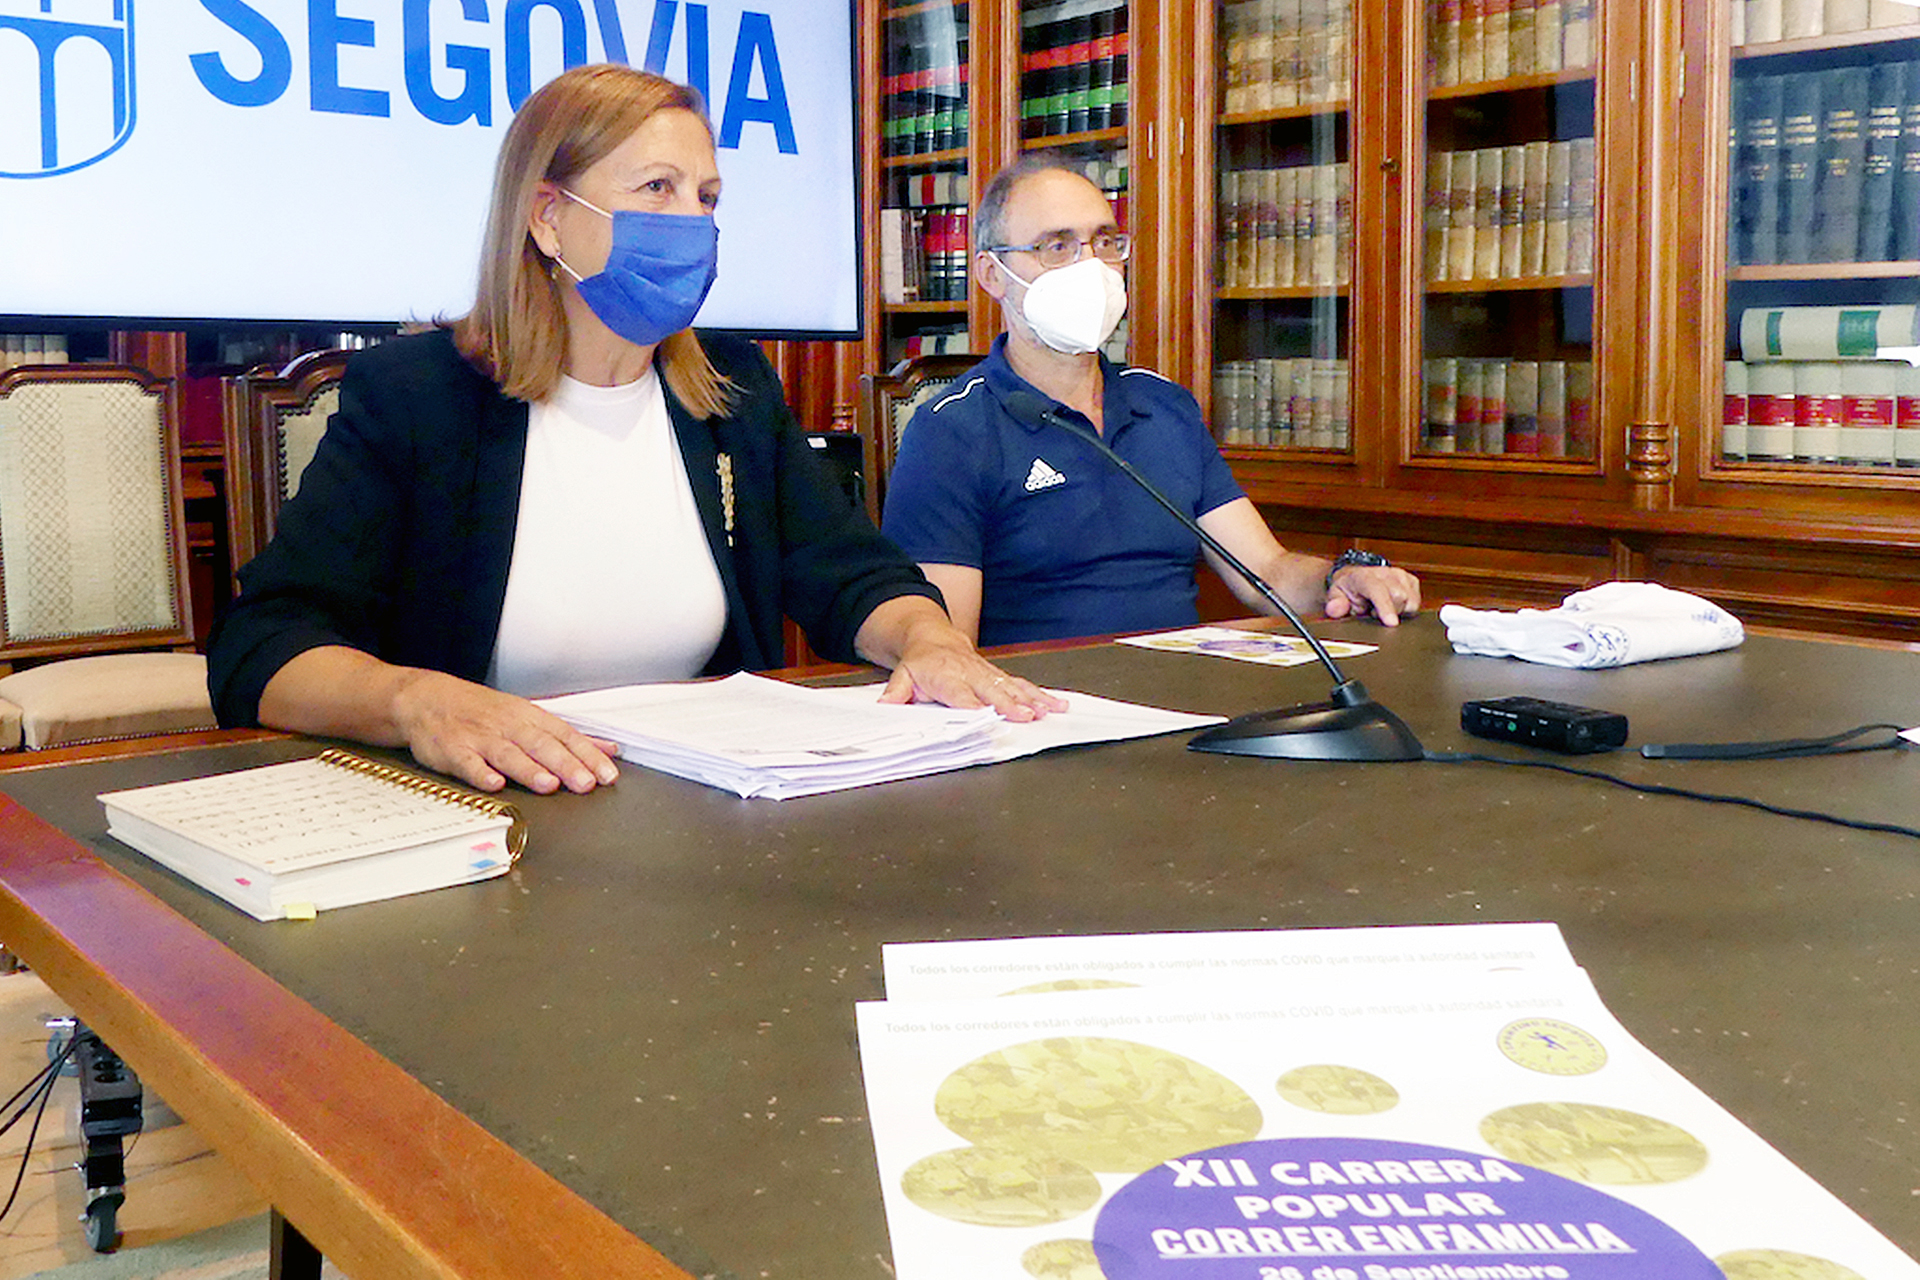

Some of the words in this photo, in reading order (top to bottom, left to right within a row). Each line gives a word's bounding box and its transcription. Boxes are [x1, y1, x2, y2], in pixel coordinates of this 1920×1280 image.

[189, 0, 799, 155] SEGOVIA
[908, 963, 947, 976] Todos
[950, 963, 969, 975] los
[972, 962, 1041, 974] corredores
[1044, 961, 1079, 973] están
[1083, 958, 1144, 973] obligados
[1158, 958, 1204, 972] cumplir
[1208, 956, 1228, 968] las
[1231, 957, 1278, 967] normas
[1281, 954, 1323, 966] COVID
[1326, 955, 1350, 966] que
[1352, 953, 1401, 965] marque
[1403, 951, 1415, 963] la
[1419, 950, 1477, 963] autoridad
[886, 1021, 927, 1034] Todos
[930, 1020, 952, 1032] los
[955, 1018, 1029, 1032] corredores
[1033, 1016, 1071, 1030] están
[1074, 1014, 1141, 1029] obligados
[1157, 1010, 1206, 1025] cumplir
[1210, 1009, 1231, 1021] las
[1235, 1009, 1286, 1020] normas
[1289, 1005, 1335, 1018] COVID
[1338, 1006, 1364, 1018] que
[1367, 1003, 1419, 1016] marque
[1422, 1001, 1435, 1013] la
[1163, 1159, 1259, 1187] XII
[1270, 1158, 1525, 1186] CARRERA
[1233, 1191, 1506, 1220] POPULAR
[1151, 1225, 1354, 1254] CORRER
[1350, 1224, 1425, 1252] EN
[1417, 1222, 1636, 1252] FAMILIA
[1311, 1264, 1359, 1280] de
[1363, 1262, 1571, 1280] Septiembre
